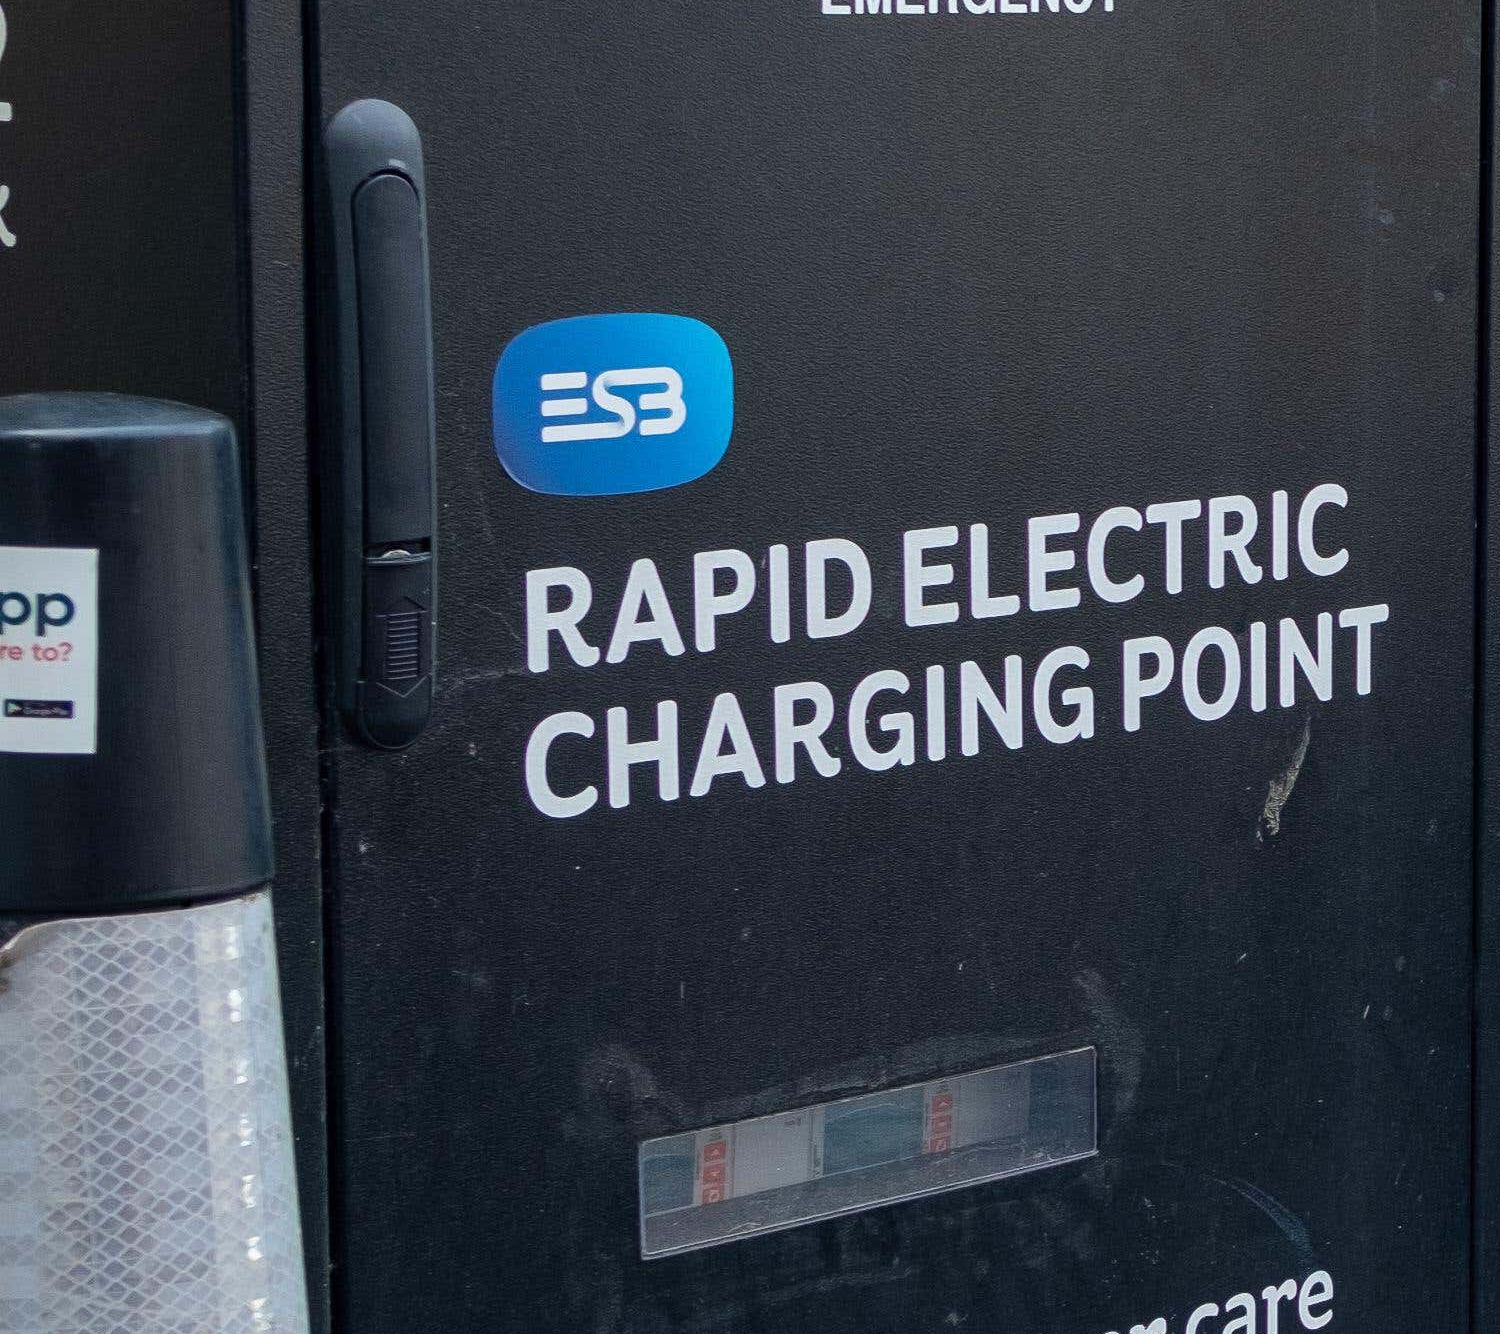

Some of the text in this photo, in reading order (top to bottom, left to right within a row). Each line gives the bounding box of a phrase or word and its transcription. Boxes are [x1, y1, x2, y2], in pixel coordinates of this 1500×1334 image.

[540, 366, 686, 443] ESB
[524, 483, 1350, 673] RAPID ELECTRIC
[32, 642, 73, 661] to?
[523, 603, 1391, 819] CHARGING POINT
